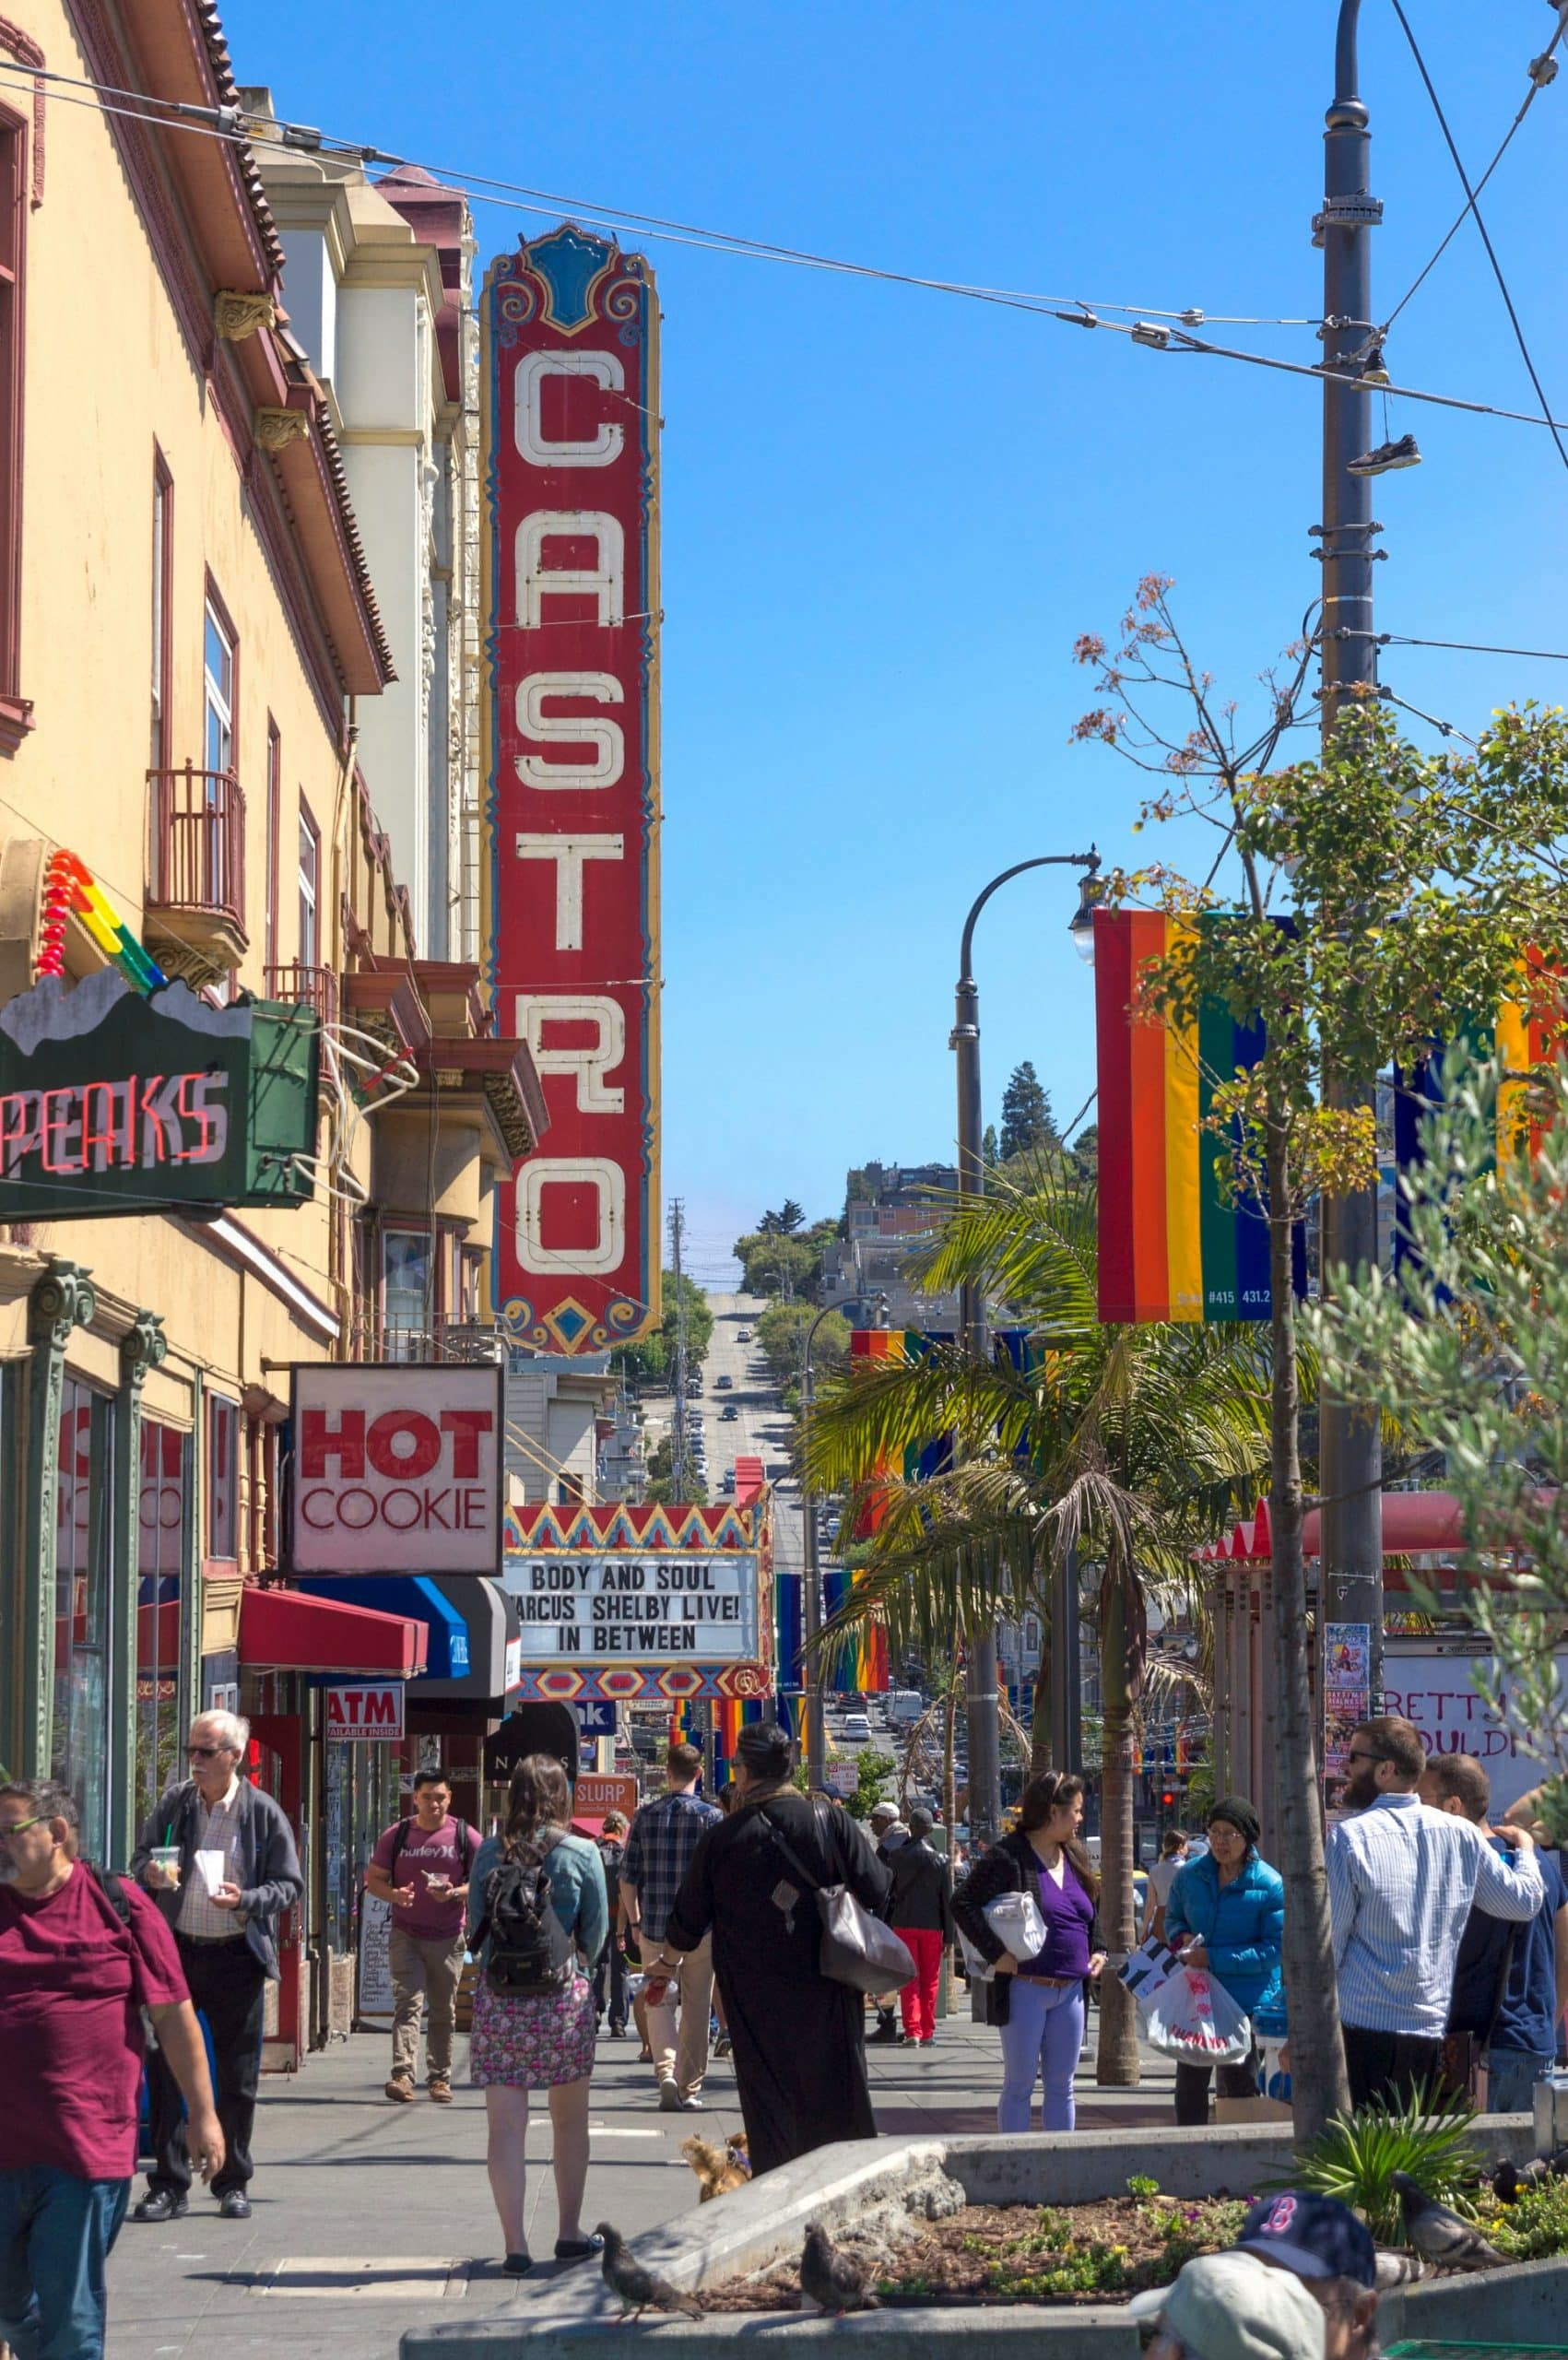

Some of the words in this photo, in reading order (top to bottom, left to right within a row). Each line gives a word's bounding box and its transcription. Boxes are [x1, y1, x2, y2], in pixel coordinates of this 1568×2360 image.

[513, 349, 626, 1276] CASTRO
[0, 1071, 230, 1180] PEAKS
[1208, 1292, 1234, 1304] #415
[1243, 1291, 1270, 1303] 431.2
[301, 1410, 492, 1480] HOT
[301, 1488, 486, 1530] COOKIE
[531, 1566, 591, 1590] BODY
[602, 1566, 645, 1590] AND
[656, 1566, 715, 1590] SOUL
[510, 1596, 575, 1621] ARCUS
[593, 1595, 670, 1621] SHELBY
[683, 1595, 739, 1620] LIVE!
[559, 1626, 580, 1651] IN
[594, 1626, 696, 1651] BETWEEN
[328, 1692, 396, 1724] ATM
[328, 1728, 367, 1737] AILABLE
[370, 1728, 399, 1737] INSIDE
[495, 1756, 569, 1770] NAS
[578, 1785, 625, 1802] SLURP
[399, 1845, 441, 1859] hurley
[1260, 2197, 1298, 2233] B
